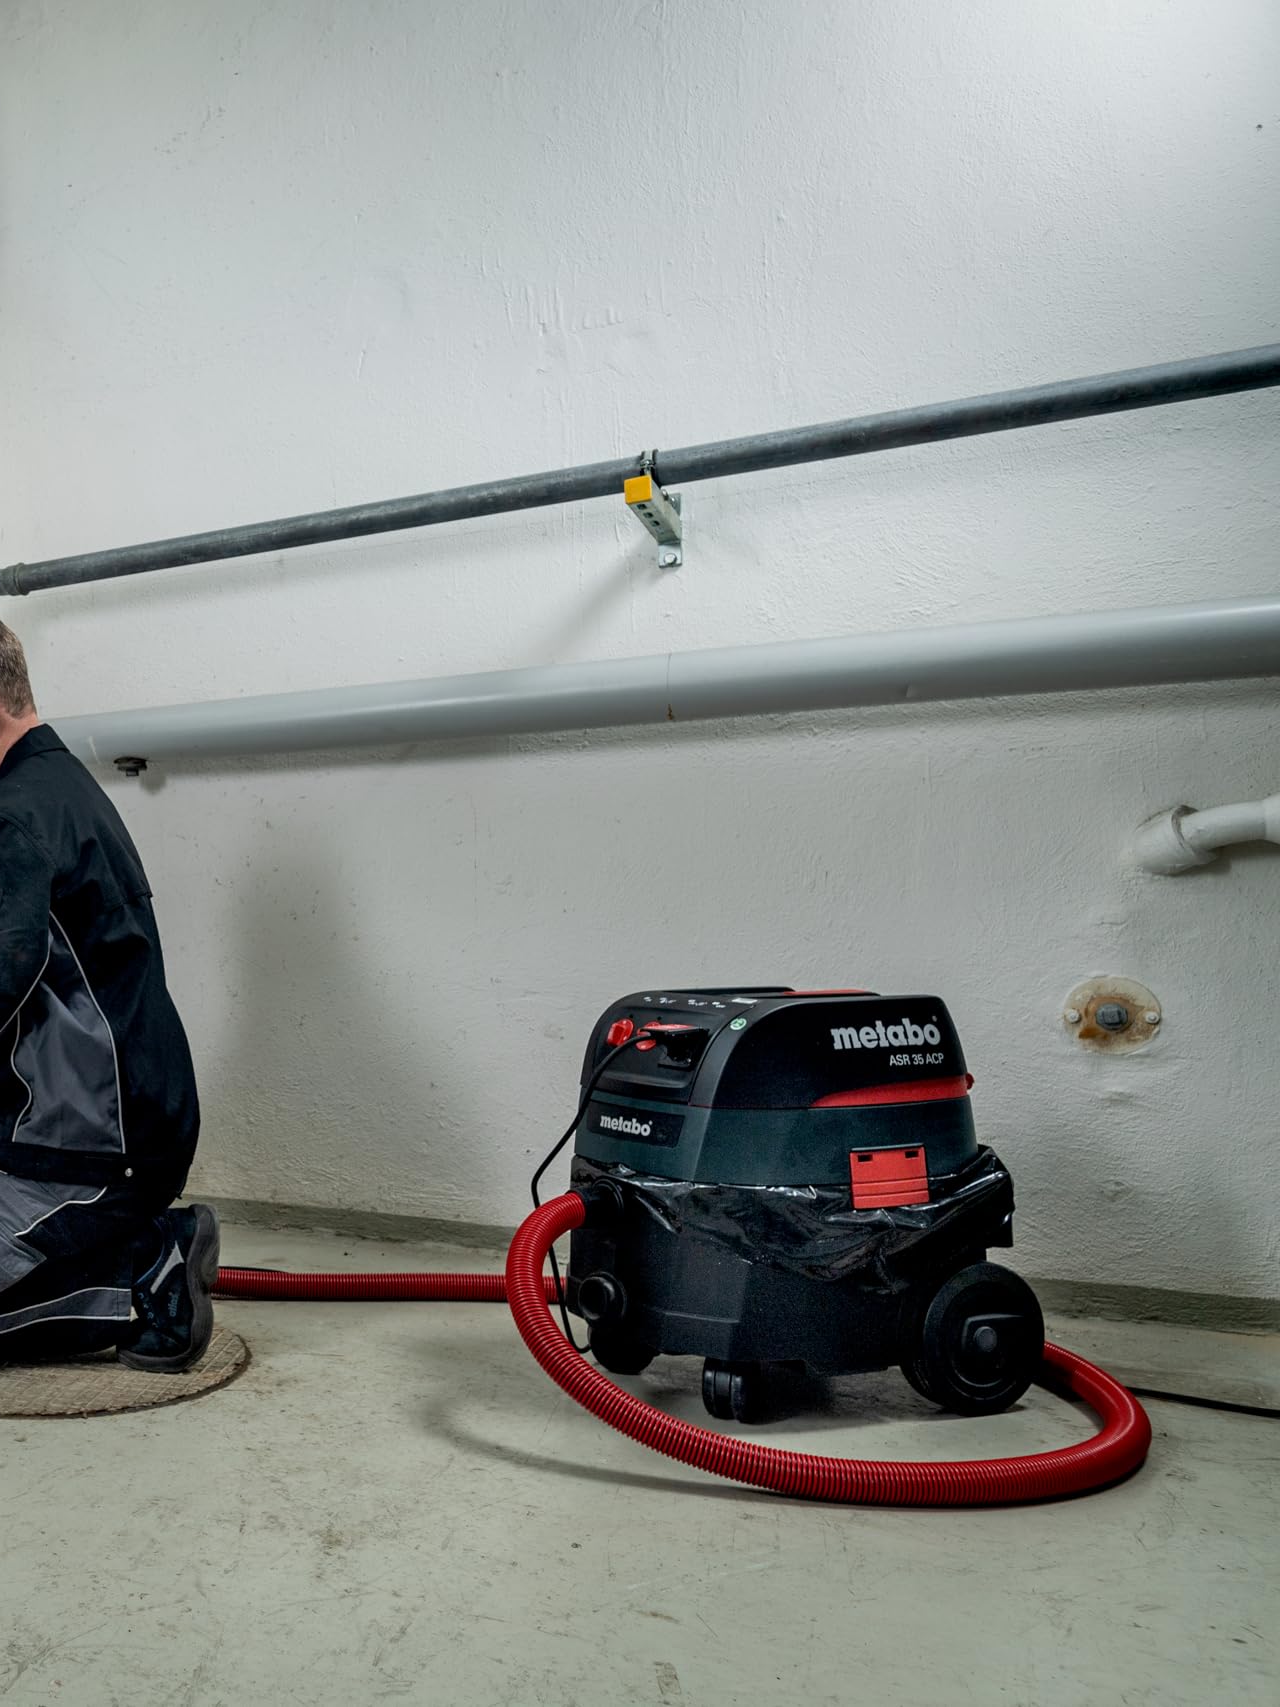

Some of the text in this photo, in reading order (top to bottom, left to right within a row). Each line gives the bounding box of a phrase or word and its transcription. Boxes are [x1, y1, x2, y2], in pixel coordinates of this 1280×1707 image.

[830, 1018, 940, 1049] metabo
[889, 1053, 944, 1066] ASR 35 ACP
[600, 1115, 651, 1136] metabo
